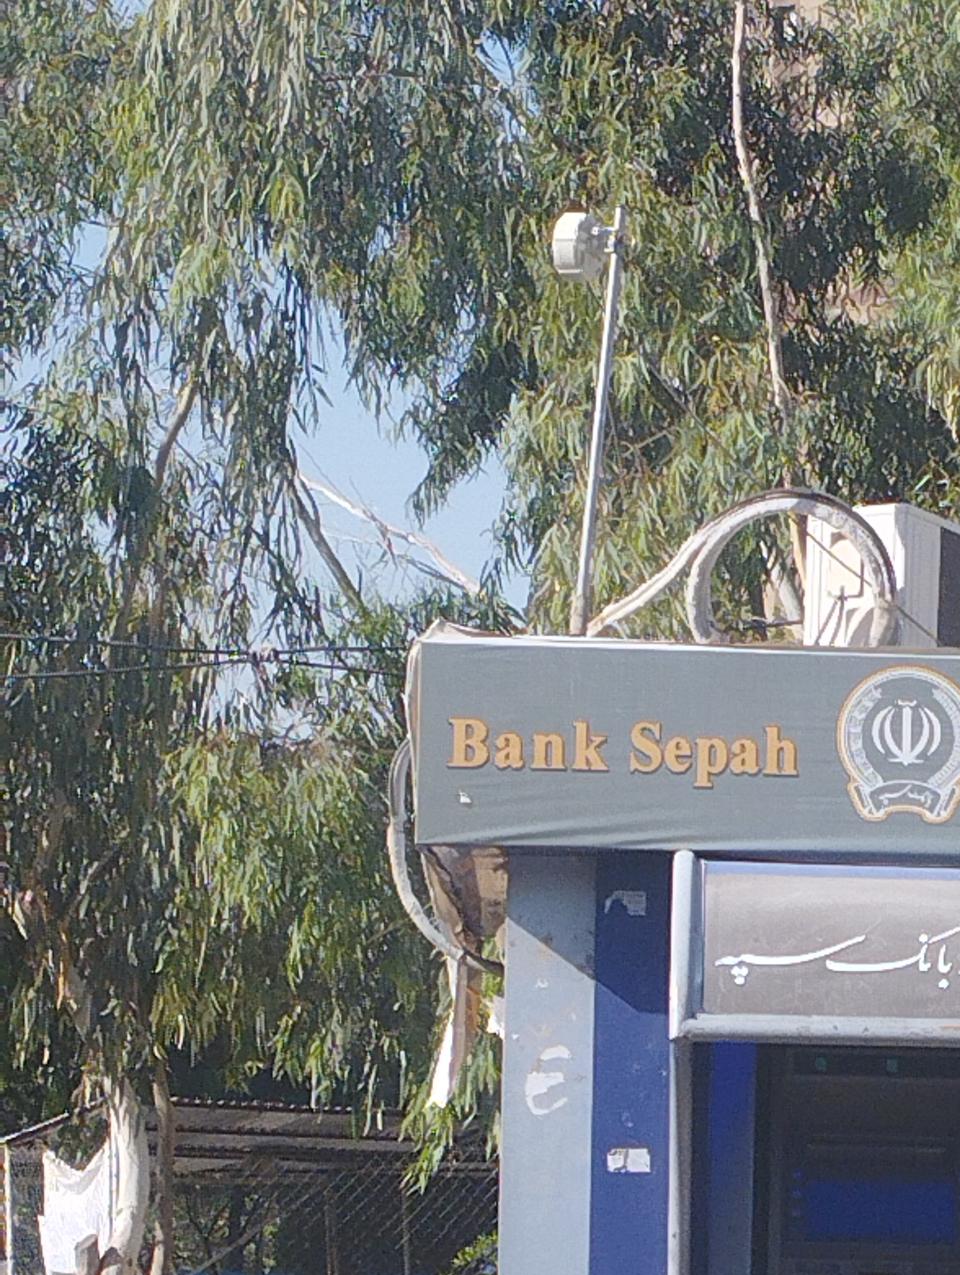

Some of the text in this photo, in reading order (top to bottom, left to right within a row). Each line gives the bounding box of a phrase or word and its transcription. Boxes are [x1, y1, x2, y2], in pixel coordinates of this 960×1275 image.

[446, 717, 799, 787] Bank Sepah
[714, 934, 867, 986] سپه
